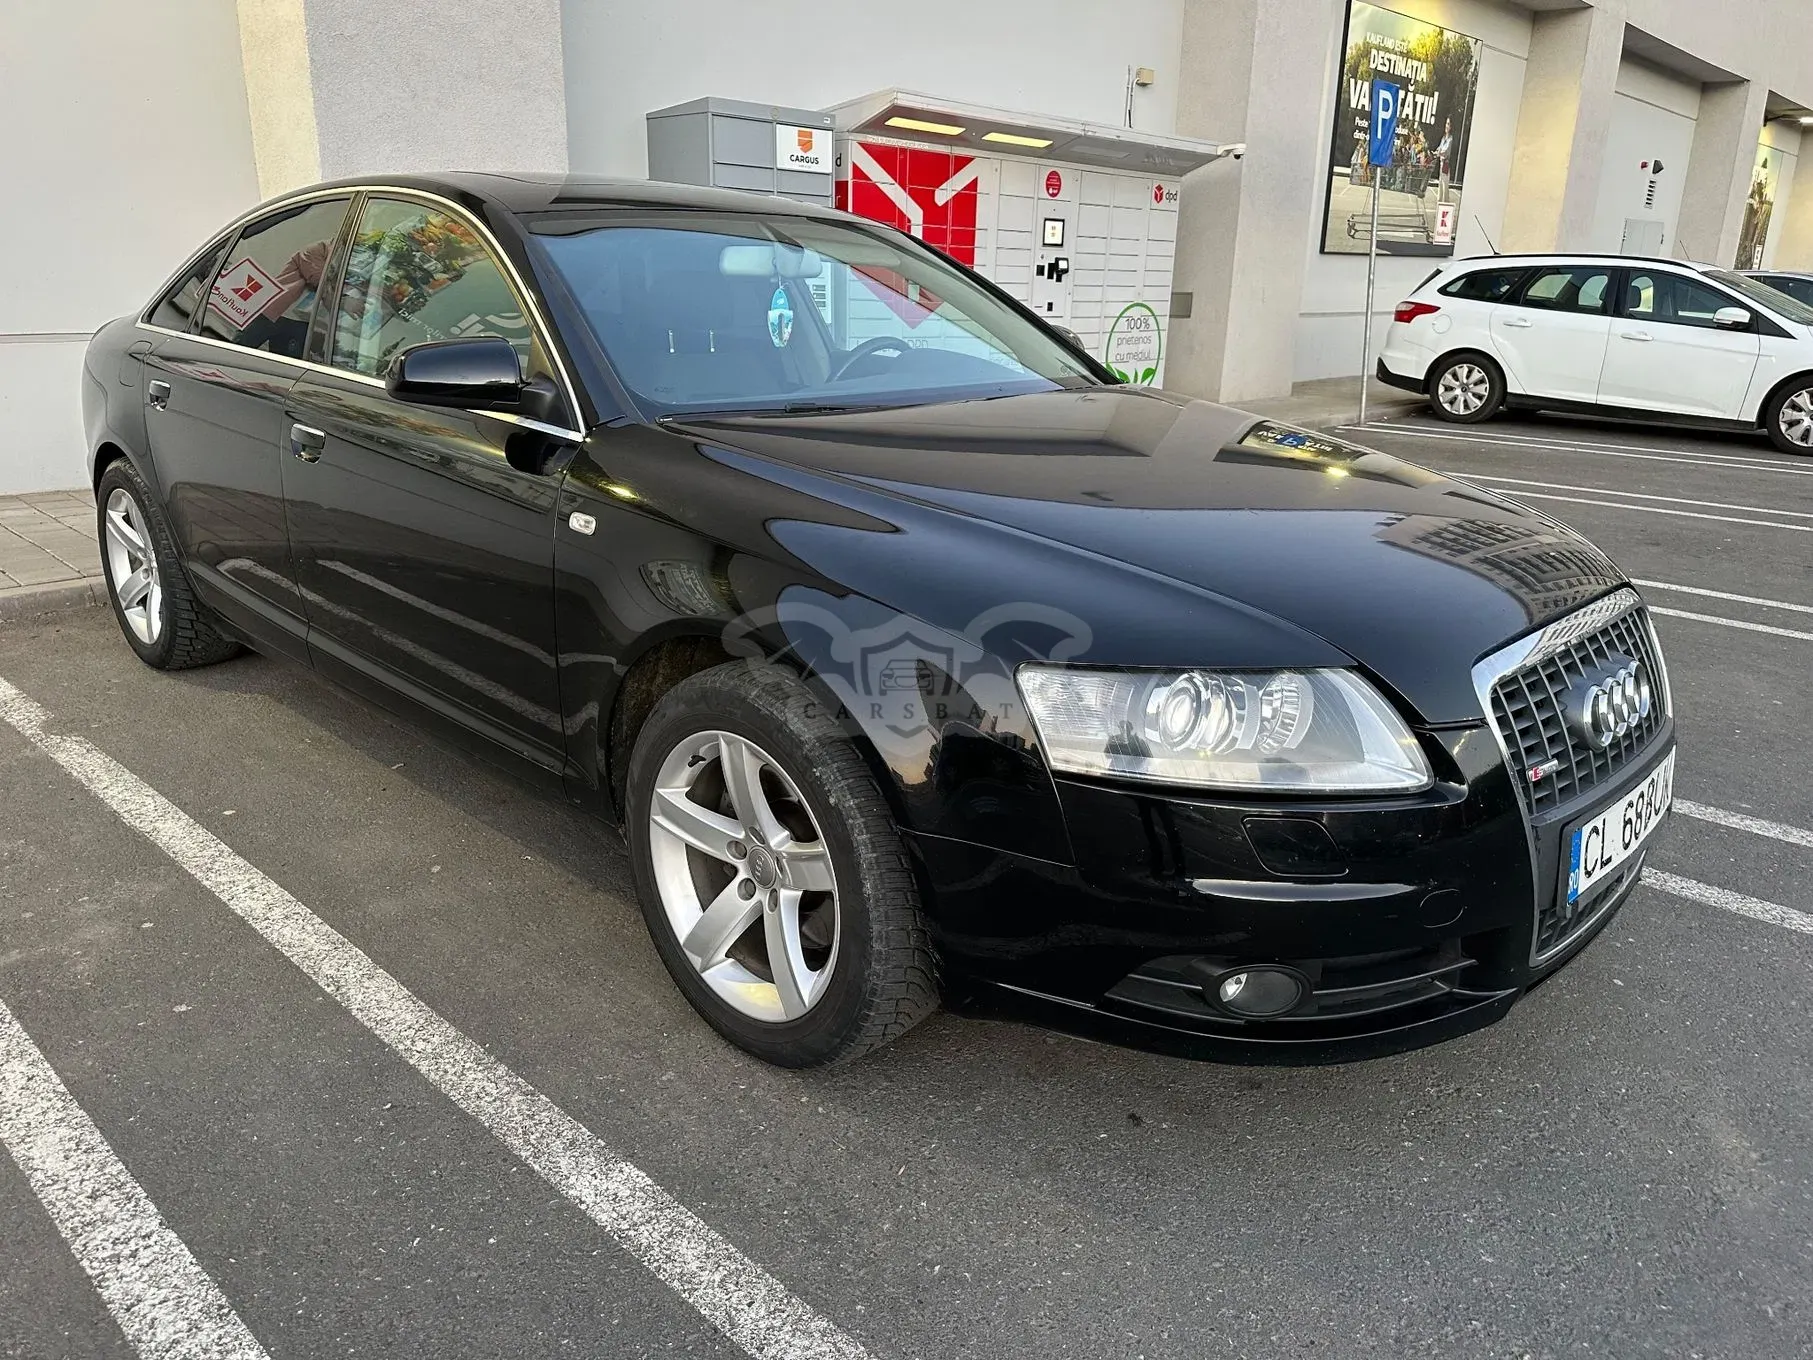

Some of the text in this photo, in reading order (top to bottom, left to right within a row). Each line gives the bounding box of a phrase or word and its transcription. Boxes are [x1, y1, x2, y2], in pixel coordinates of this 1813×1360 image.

[1369, 48, 1427, 85] DESTINAȚIA
[1377, 89, 1393, 140] P
[789, 154, 820, 165] CARGUS
[1165, 189, 1178, 203] dpd
[1125, 317, 1151, 330] 100%
[1116, 336, 1152, 348] prietenos
[1115, 352, 1125, 361] cu
[1584, 817, 1612, 879] CL
[1568, 868, 1579, 895] RO
